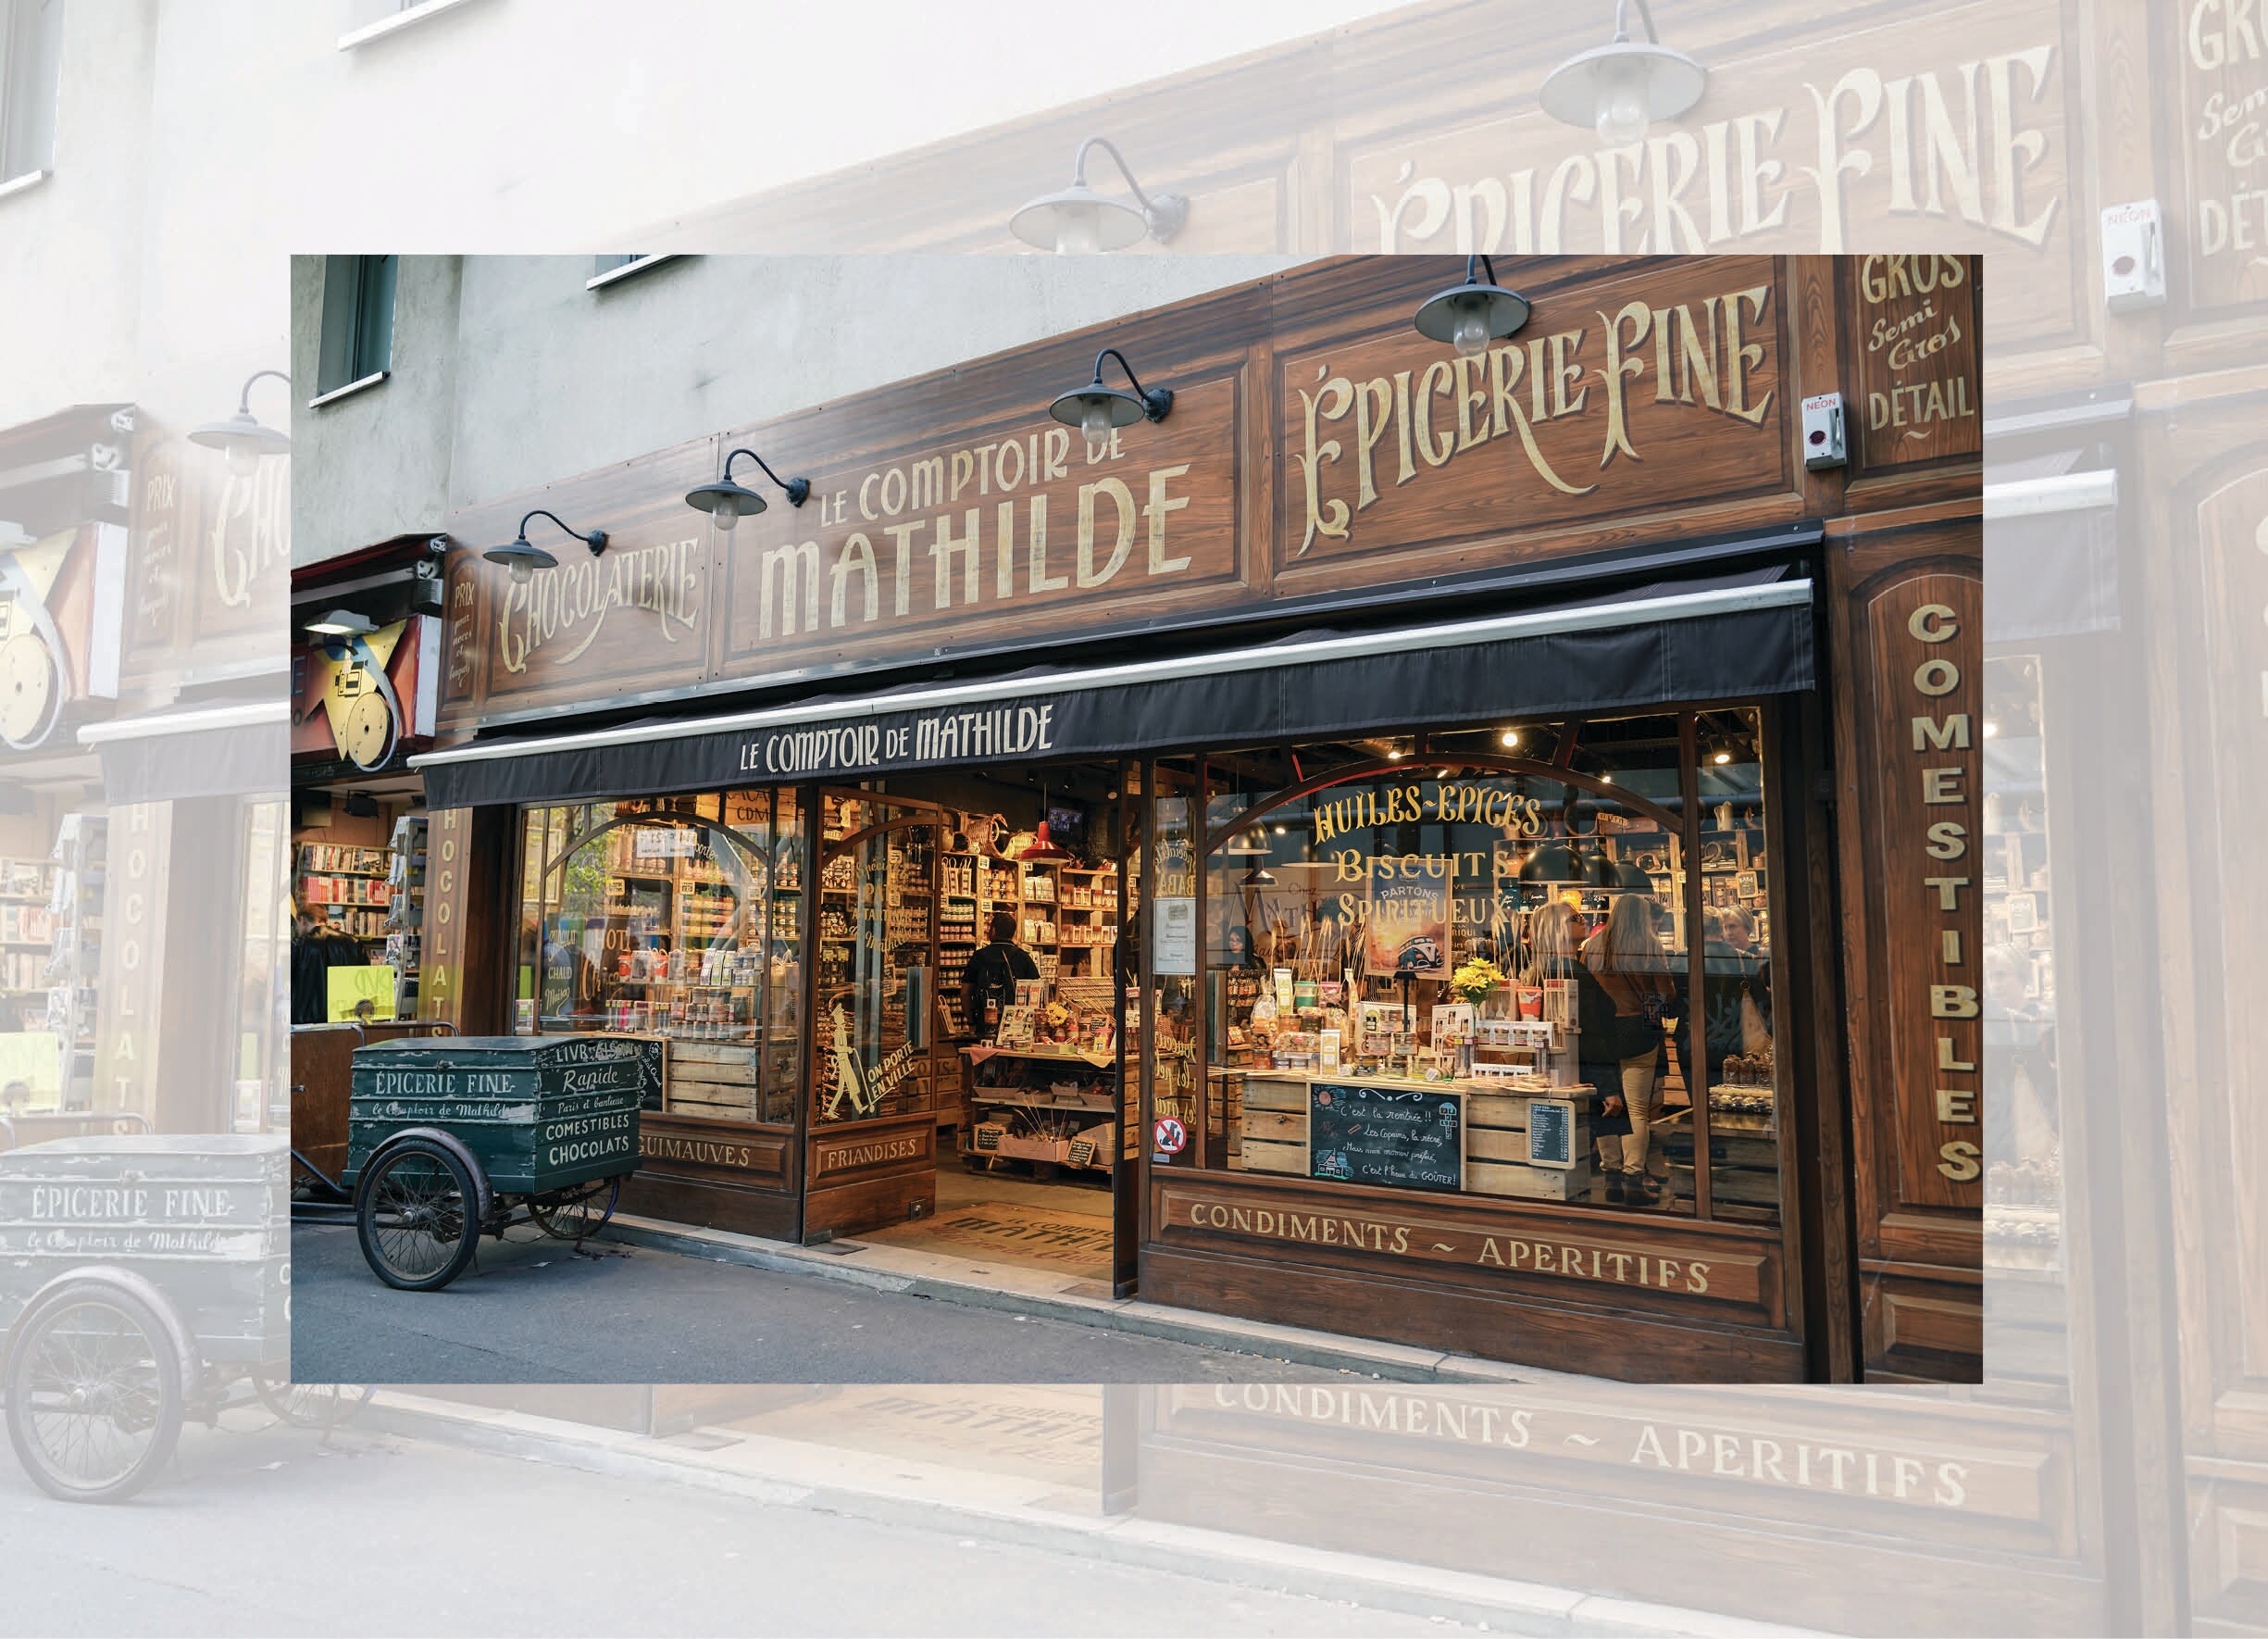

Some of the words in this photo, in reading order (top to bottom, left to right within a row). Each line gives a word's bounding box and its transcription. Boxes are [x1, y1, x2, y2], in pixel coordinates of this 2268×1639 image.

[1801, 44, 2059, 256] FINE
[1862, 255, 1964, 305] GROS
[1868, 298, 1938, 352] Semi
[1888, 315, 1962, 370] Gros
[1295, 328, 1601, 557] ÉPICERIE
[1594, 286, 1775, 467] FINE
[1806, 398, 1838, 413] NEON
[1869, 376, 1975, 432] DÉTAIL
[821, 488, 847, 528] LE
[859, 427, 1068, 521] COMPTOIR
[759, 463, 1191, 640] MATHILDE
[455, 581, 475, 608] PRIX
[499, 537, 700, 676] CHOCOLATERIE
[741, 744, 759, 771] LE
[766, 725, 879, 774] COMPTOIR
[885, 729, 909, 760] DE
[916, 705, 1053, 760] MATHILDE
[1315, 784, 1423, 846] HUILES
[1436, 784, 1542, 836] EPICES
[1334, 848, 1509, 882] BISCUITS
[1908, 603, 1982, 1182] COMESTIBLES
[375, 1070, 455, 1095] ÉPICERIE
[467, 1073, 512, 1094] FINE
[563, 1066, 618, 1093] Rapide
[866, 1067, 882, 1084] ON
[883, 1040, 915, 1070] PORTE
[871, 1080, 887, 1100] EN
[887, 1057, 916, 1087] VILLE
[546, 1114, 629, 1141] COMESTIBLES
[549, 1135, 629, 1167] CHOCOLATS
[828, 1138, 916, 1170] FRIANDISES
[31, 1184, 149, 1220] ÉPICERIE
[1190, 1203, 1412, 1255] CONDIMENTS
[1477, 1237, 1712, 1295] APERITIFS
[1214, 1384, 1535, 1450] CONDIMENTS
[1630, 1424, 1972, 1509] APERITIFS
